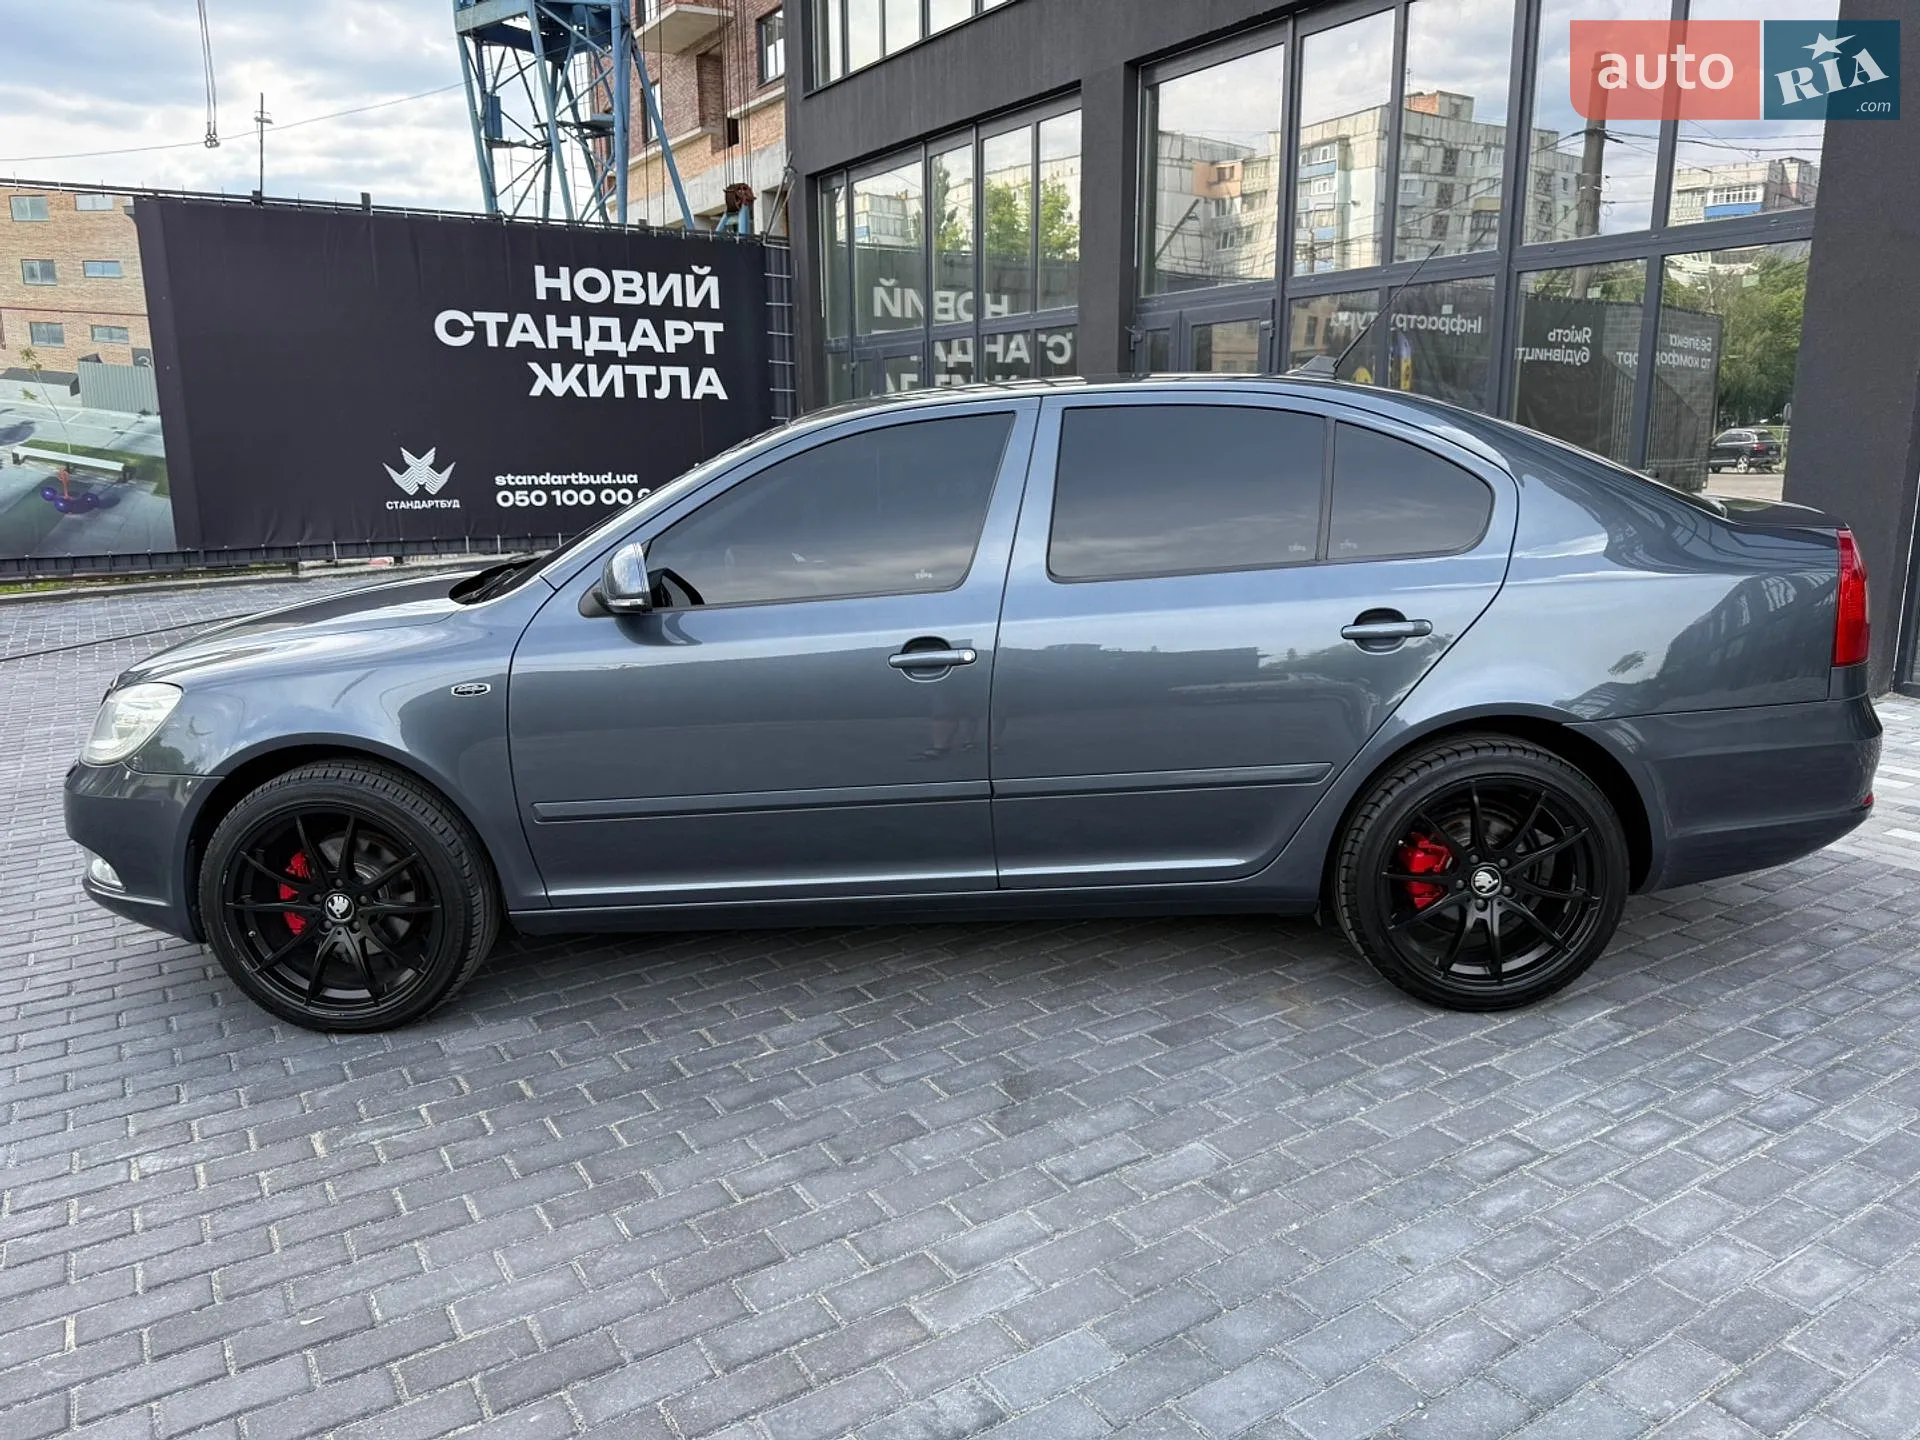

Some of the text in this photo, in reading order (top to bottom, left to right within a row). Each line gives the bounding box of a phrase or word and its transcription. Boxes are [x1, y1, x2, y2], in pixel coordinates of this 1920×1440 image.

[533, 265, 720, 310] НОВИЙ
[433, 309, 724, 358] СТАНДАРТ
[527, 362, 729, 401] ЖИТЛА
[494, 471, 639, 486] standartbud.ua
[385, 499, 461, 511] СТАНДАРТБУД
[495, 489, 548, 507] 050
[550, 488, 596, 506] 100
[600, 487, 634, 505] 00
